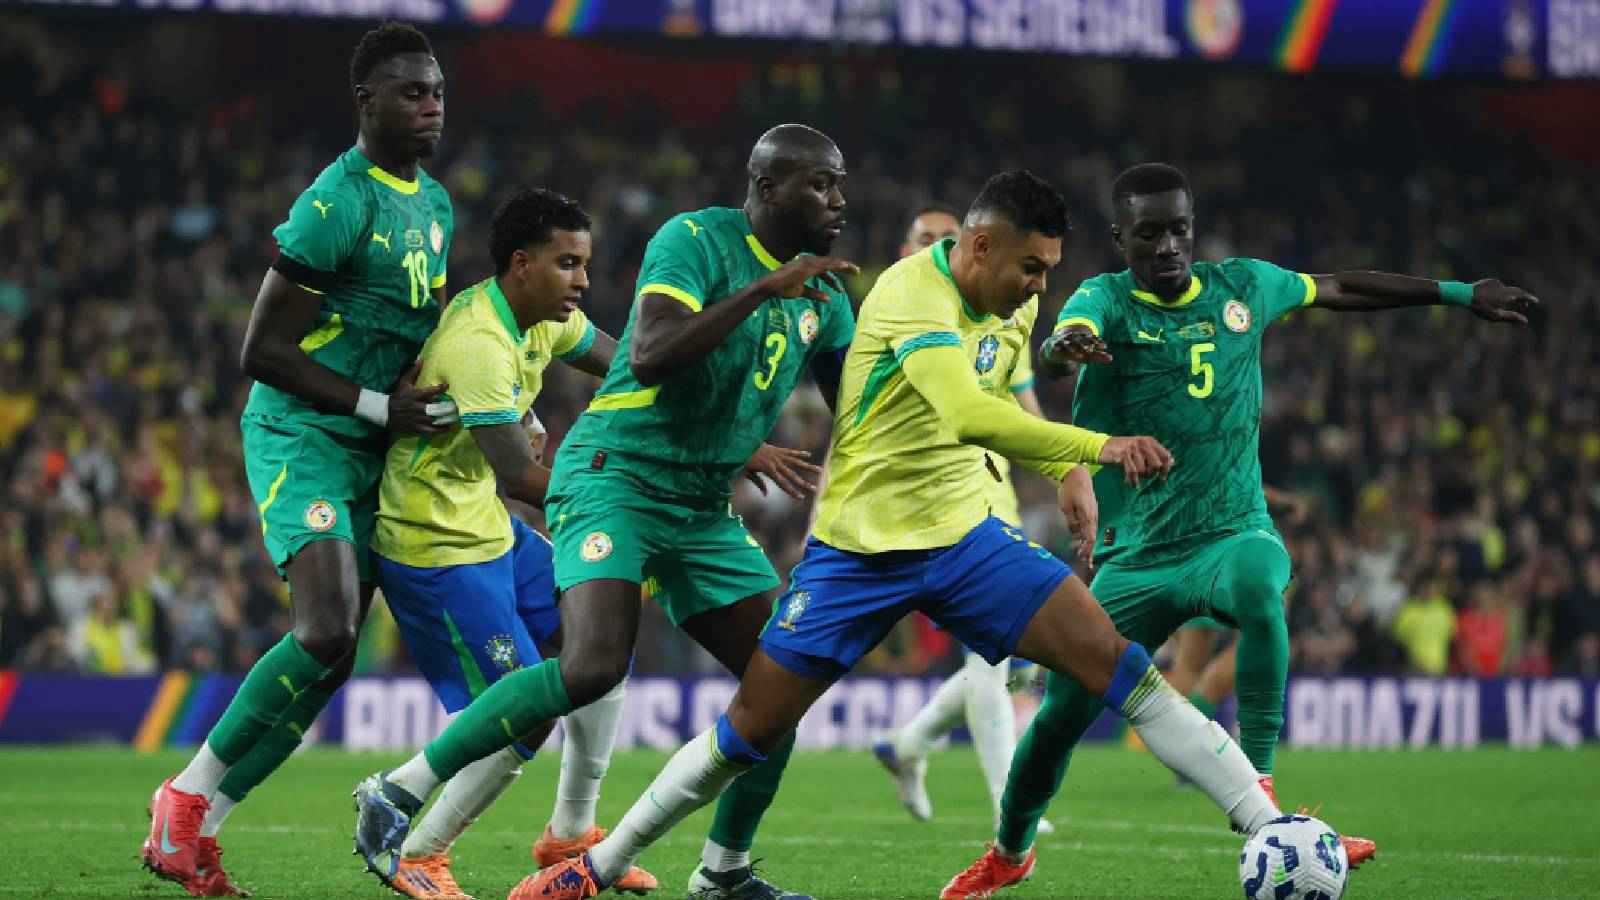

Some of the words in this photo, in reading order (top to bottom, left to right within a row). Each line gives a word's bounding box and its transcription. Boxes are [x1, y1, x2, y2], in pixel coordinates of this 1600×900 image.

[402, 250, 430, 309] 19
[754, 332, 787, 391] 3
[1187, 342, 1216, 399] 5
[1504, 677, 1584, 750] VS
